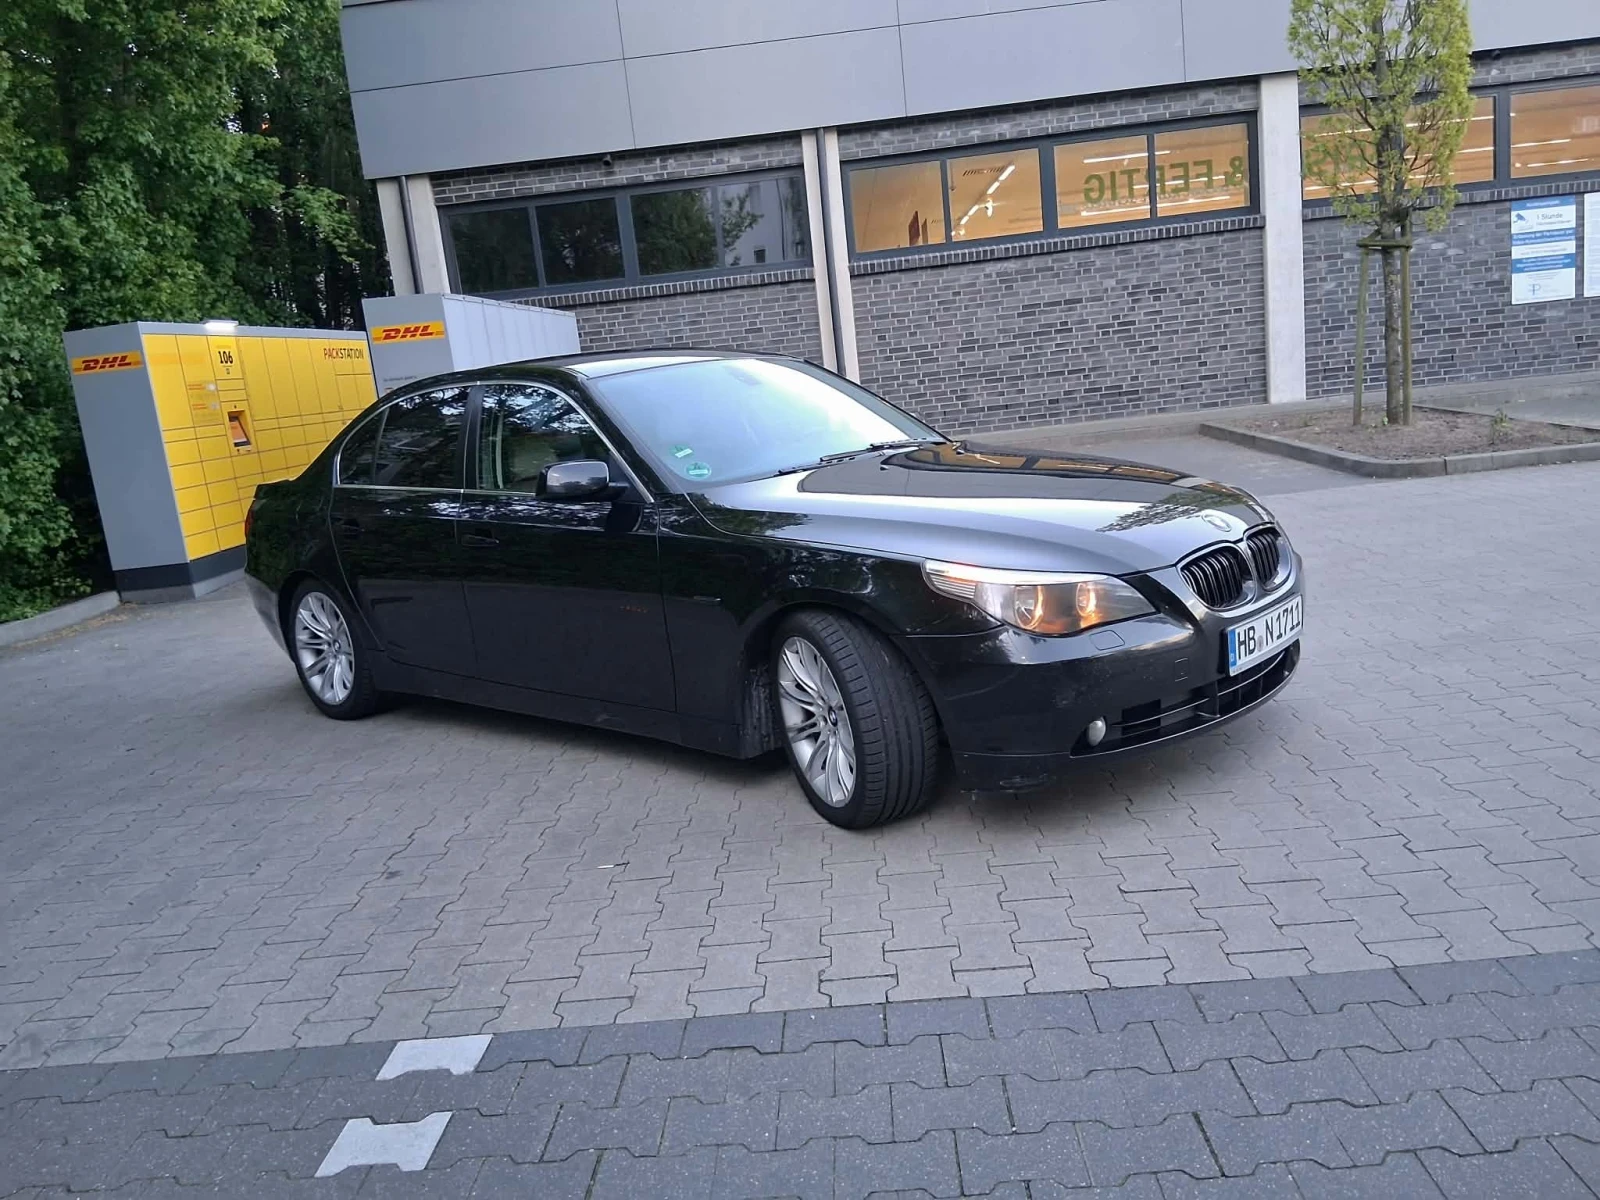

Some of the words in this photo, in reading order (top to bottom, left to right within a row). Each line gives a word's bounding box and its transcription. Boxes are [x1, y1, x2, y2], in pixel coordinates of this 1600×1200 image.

[1541, 212, 1563, 221] Stunde
[381, 325, 435, 340] DHL
[217, 350, 234, 364] 106
[323, 347, 365, 360] PACKSTATION
[81, 355, 132, 371] DHL
[1237, 625, 1257, 661] HB
